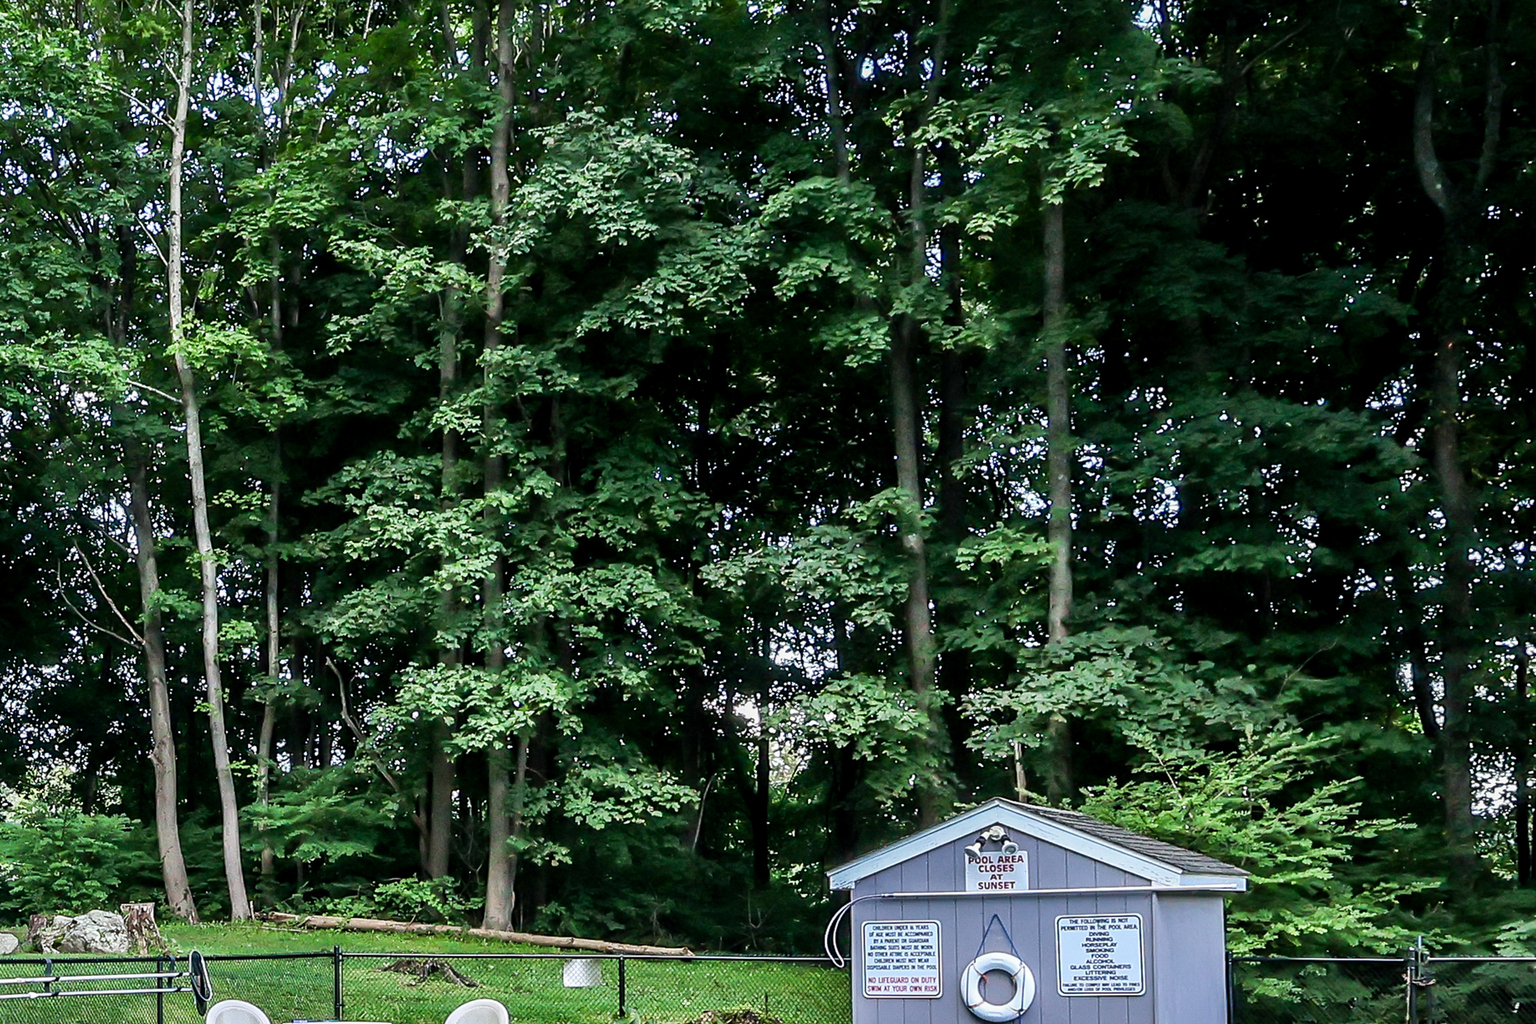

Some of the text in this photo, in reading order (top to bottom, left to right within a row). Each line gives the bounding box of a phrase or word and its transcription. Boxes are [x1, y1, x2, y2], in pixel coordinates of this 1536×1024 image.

[968, 855, 1024, 864] POOL AREA
[978, 864, 1014, 873] CLOSES
[978, 881, 1016, 890] SUNSET
